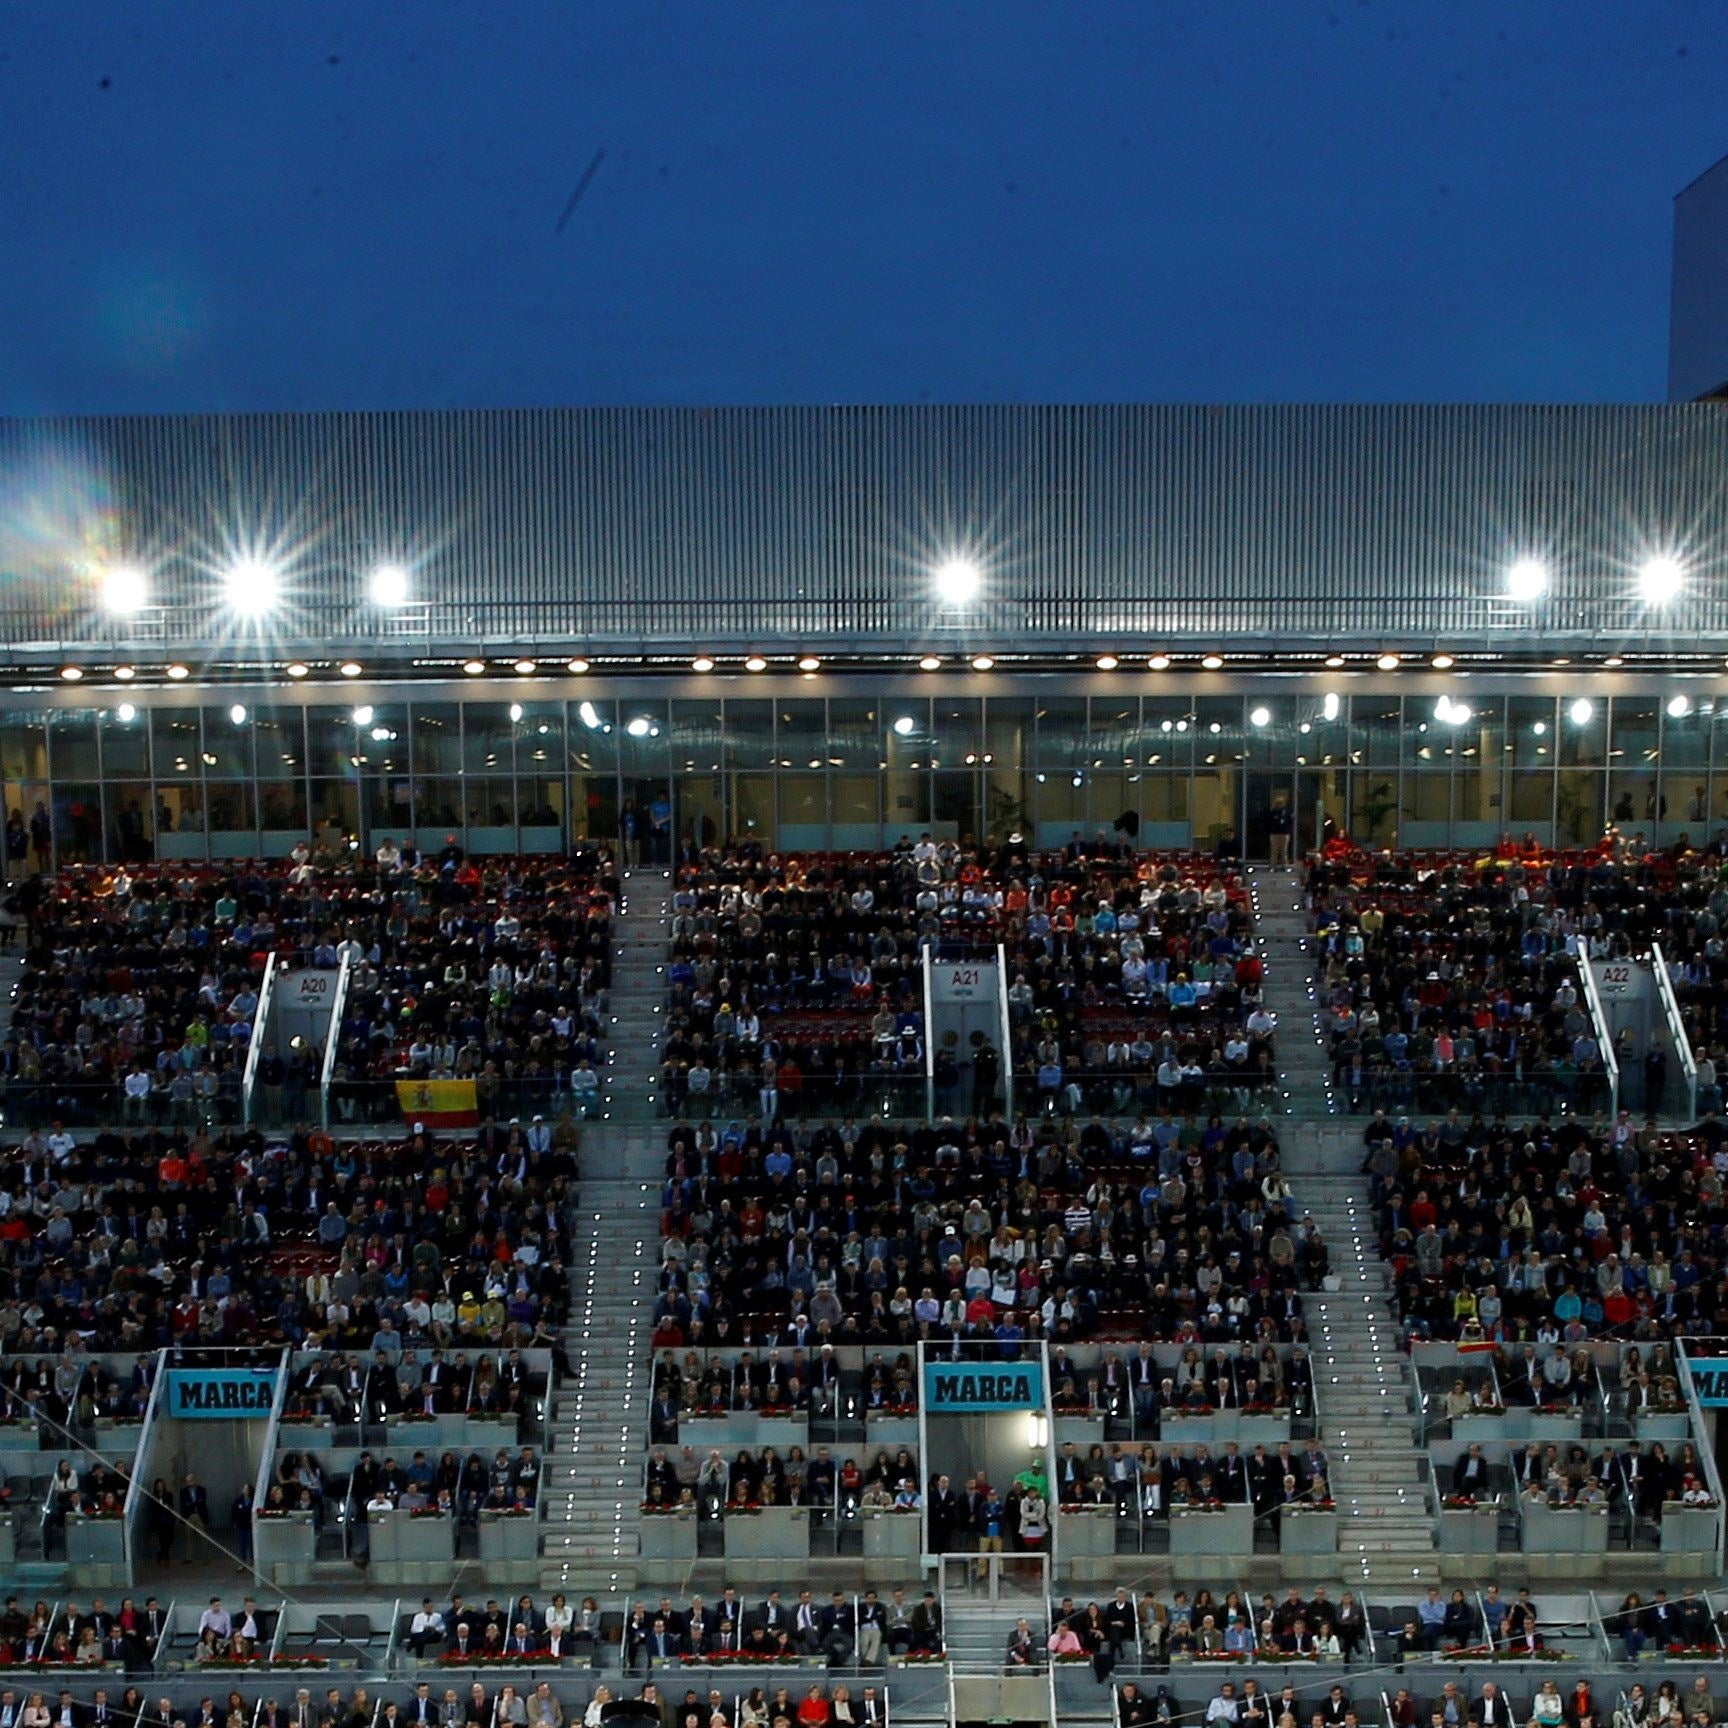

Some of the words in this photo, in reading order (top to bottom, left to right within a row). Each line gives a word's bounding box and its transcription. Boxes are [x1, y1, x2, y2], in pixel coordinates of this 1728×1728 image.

[301, 978, 327, 993] A20
[952, 969, 979, 985] A21
[178, 1381, 273, 1410] MARCA
[934, 1374, 1033, 1404] MARCA
